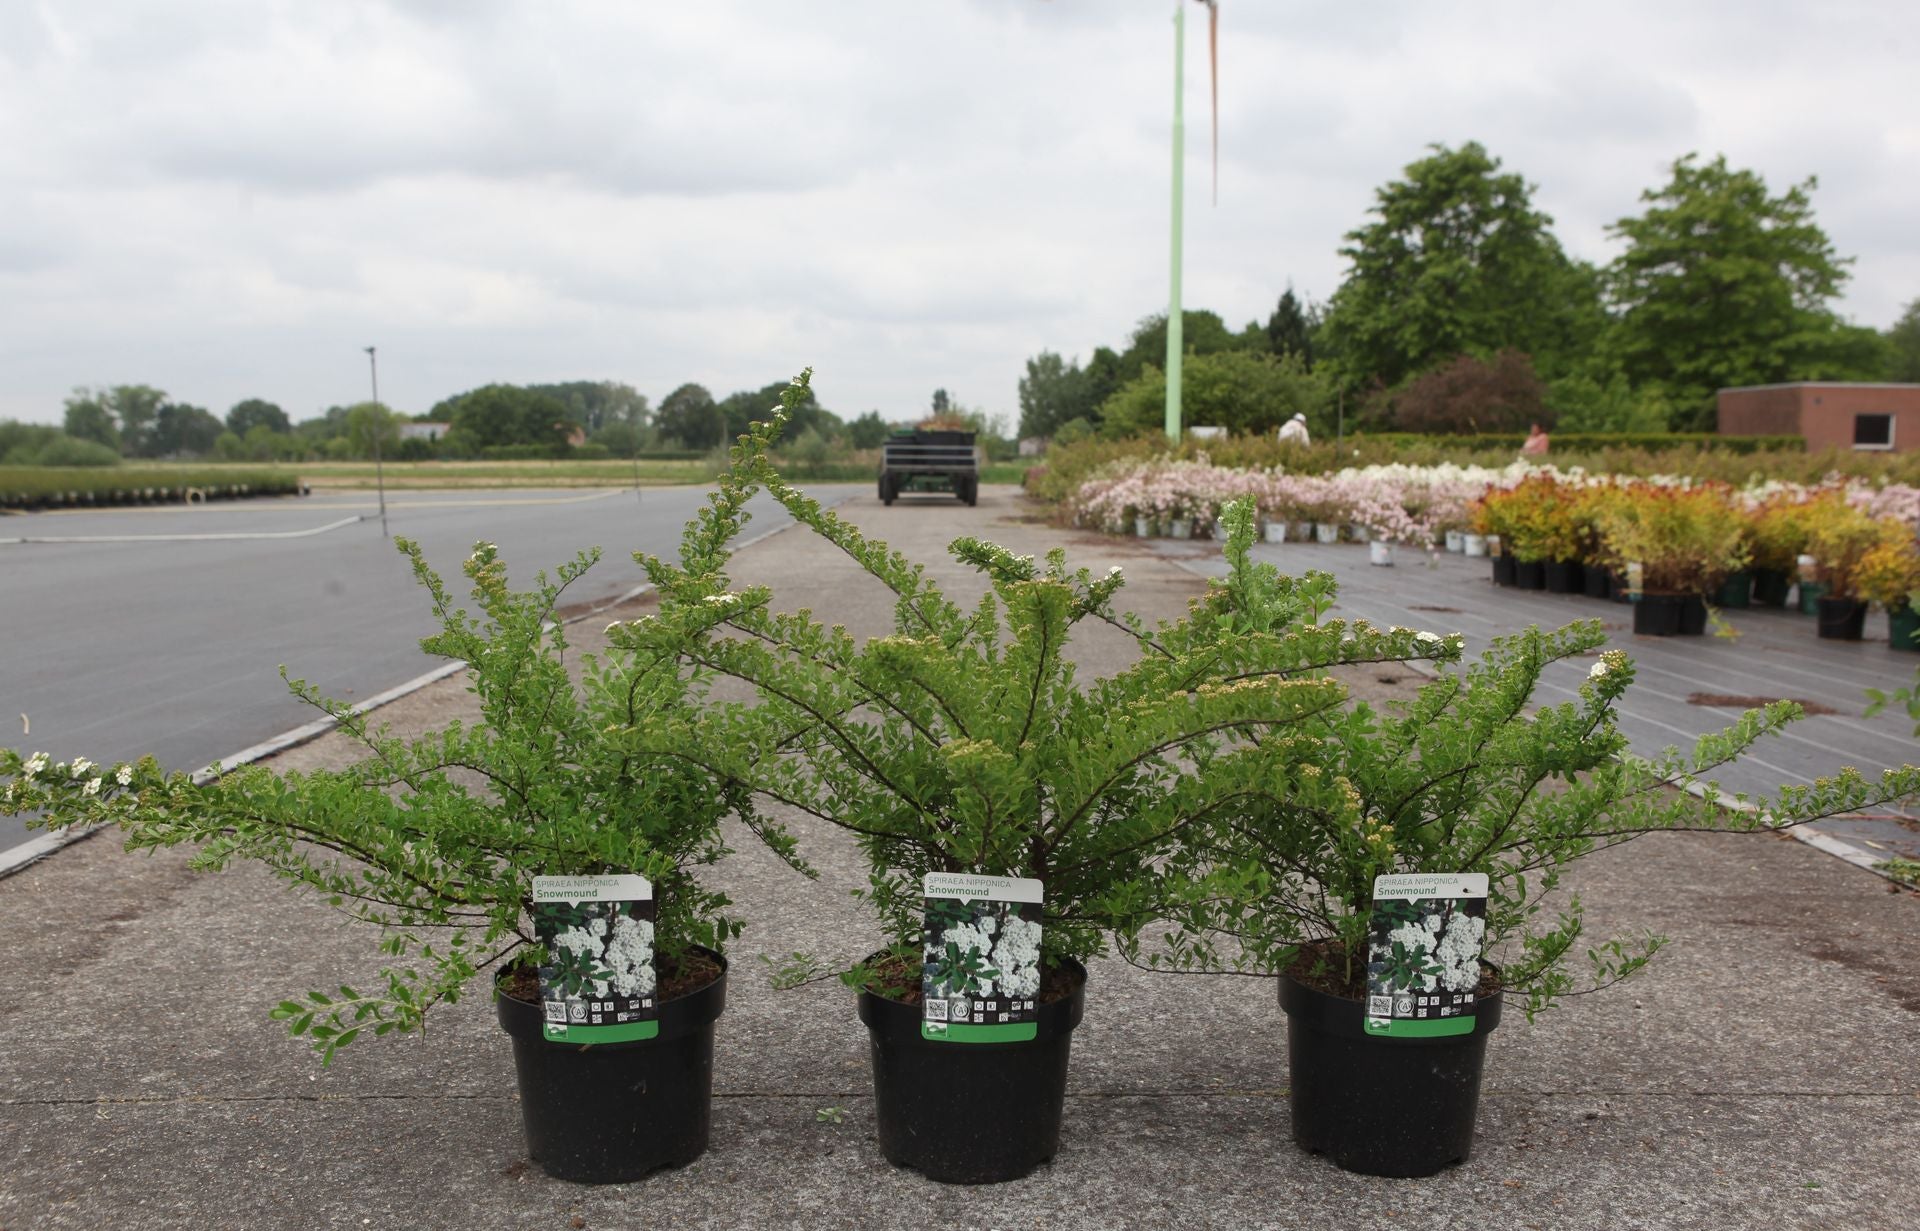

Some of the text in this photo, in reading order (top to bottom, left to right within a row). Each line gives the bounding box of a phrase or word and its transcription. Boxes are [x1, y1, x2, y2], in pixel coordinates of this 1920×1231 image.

[536, 879, 619, 888] SPIRAEA NIPPONICA
[928, 876, 1012, 888] SPIRAEA NIPPONICA
[1379, 877, 1459, 887] SPIRAEA NIPPONICA
[536, 888, 598, 898] Snowmound
[928, 885, 990, 896] Snowmound
[1377, 886, 1437, 896] Snowmound
